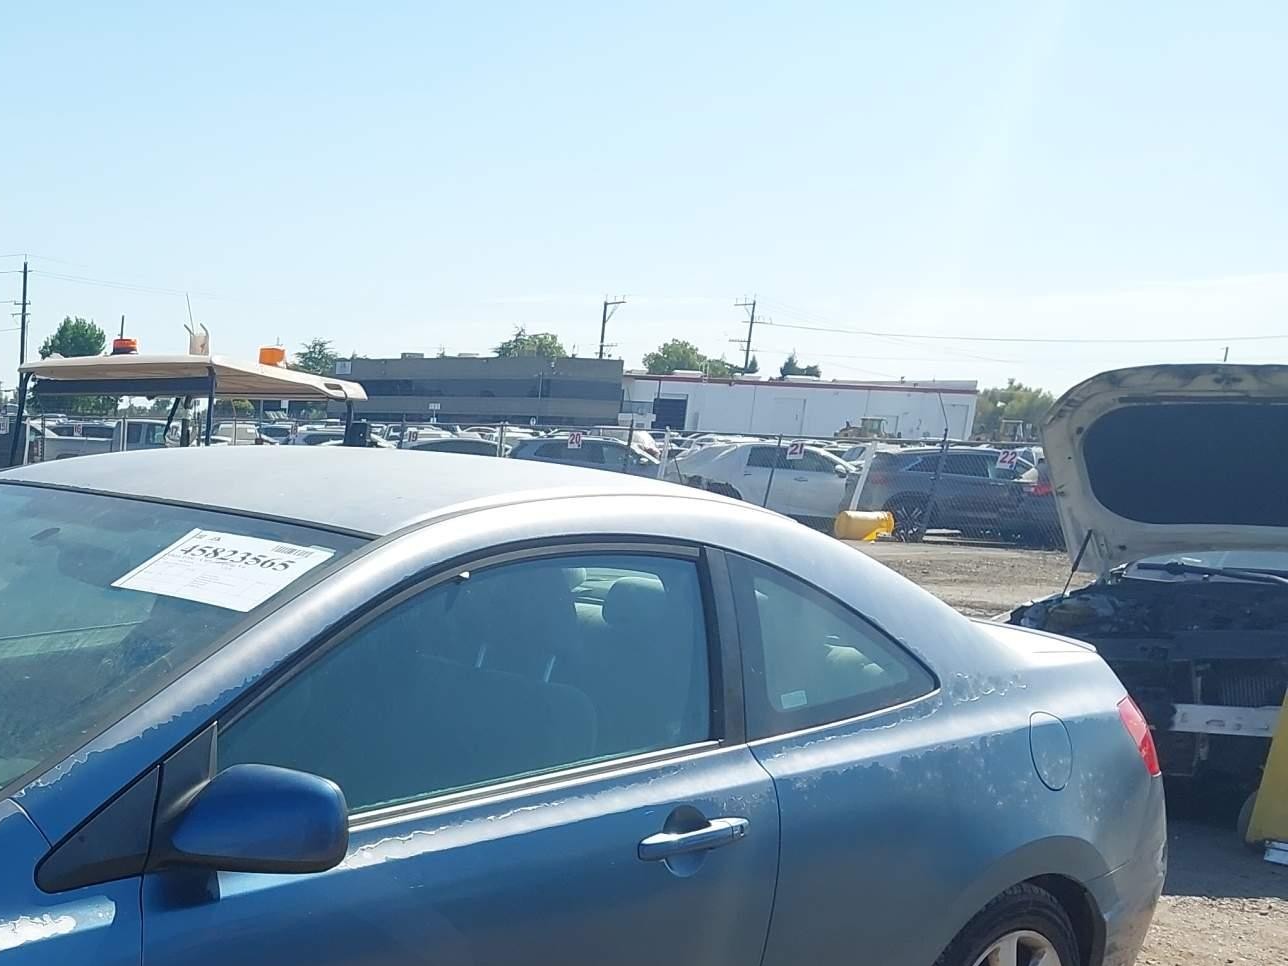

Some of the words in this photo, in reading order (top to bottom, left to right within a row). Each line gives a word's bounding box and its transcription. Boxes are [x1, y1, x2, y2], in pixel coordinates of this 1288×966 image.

[408, 431, 418, 442] 19
[569, 433, 581, 444] 20
[789, 443, 804, 455] 21
[1000, 451, 1017, 464] 22
[181, 545, 296, 572] 45823565
